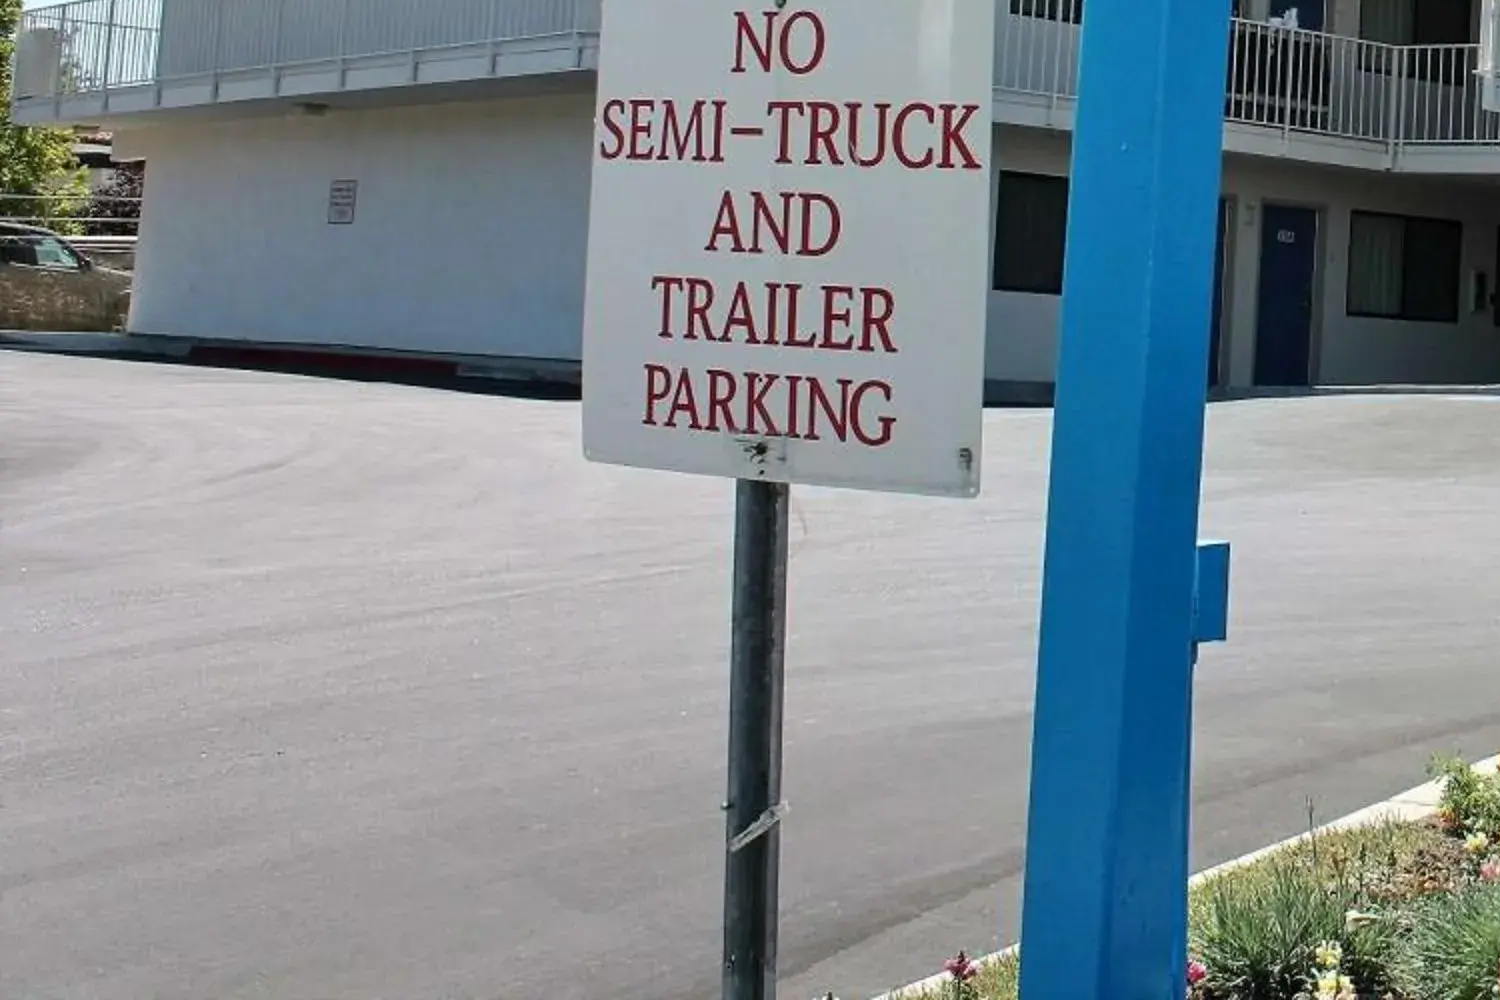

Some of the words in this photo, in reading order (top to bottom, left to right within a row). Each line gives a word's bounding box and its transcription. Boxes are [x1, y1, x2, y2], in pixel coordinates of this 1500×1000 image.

[730, 10, 826, 75] NO
[599, 99, 982, 169] SEMI-TRUCK
[704, 190, 841, 256] AND
[651, 275, 898, 353] TRAILER
[642, 363, 897, 446] PARKING
